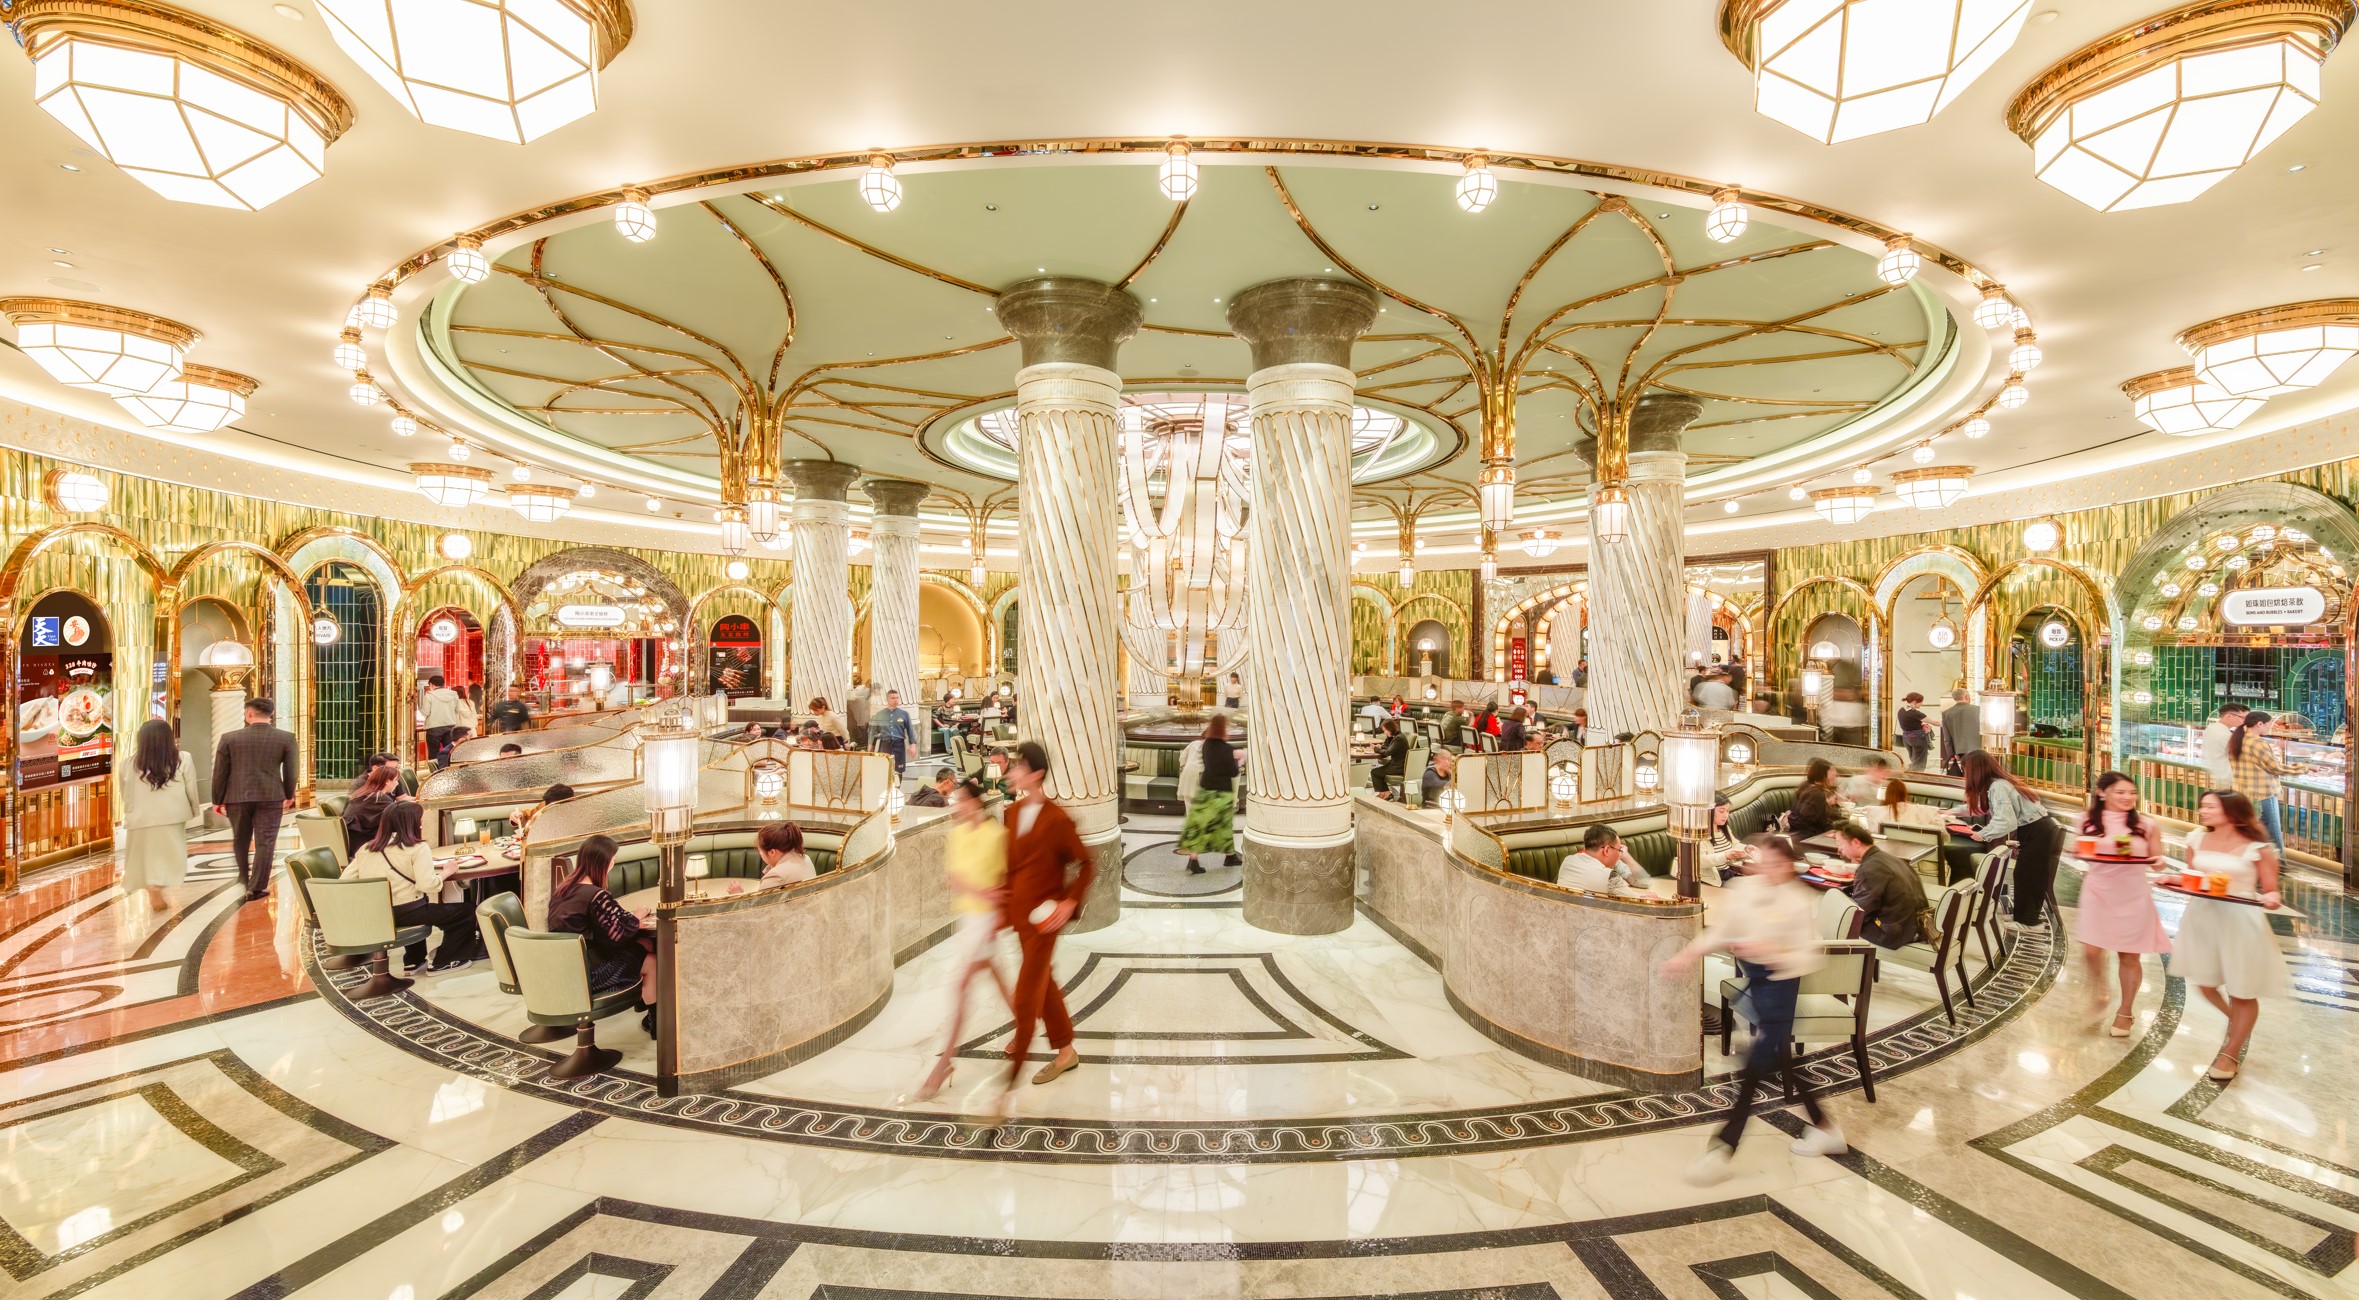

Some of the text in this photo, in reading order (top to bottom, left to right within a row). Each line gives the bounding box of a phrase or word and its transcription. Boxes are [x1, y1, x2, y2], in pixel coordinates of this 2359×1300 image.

[2245, 598, 2304, 608] 如珠如包烘焙茶飲
[719, 622, 750, 631] 陶小串
